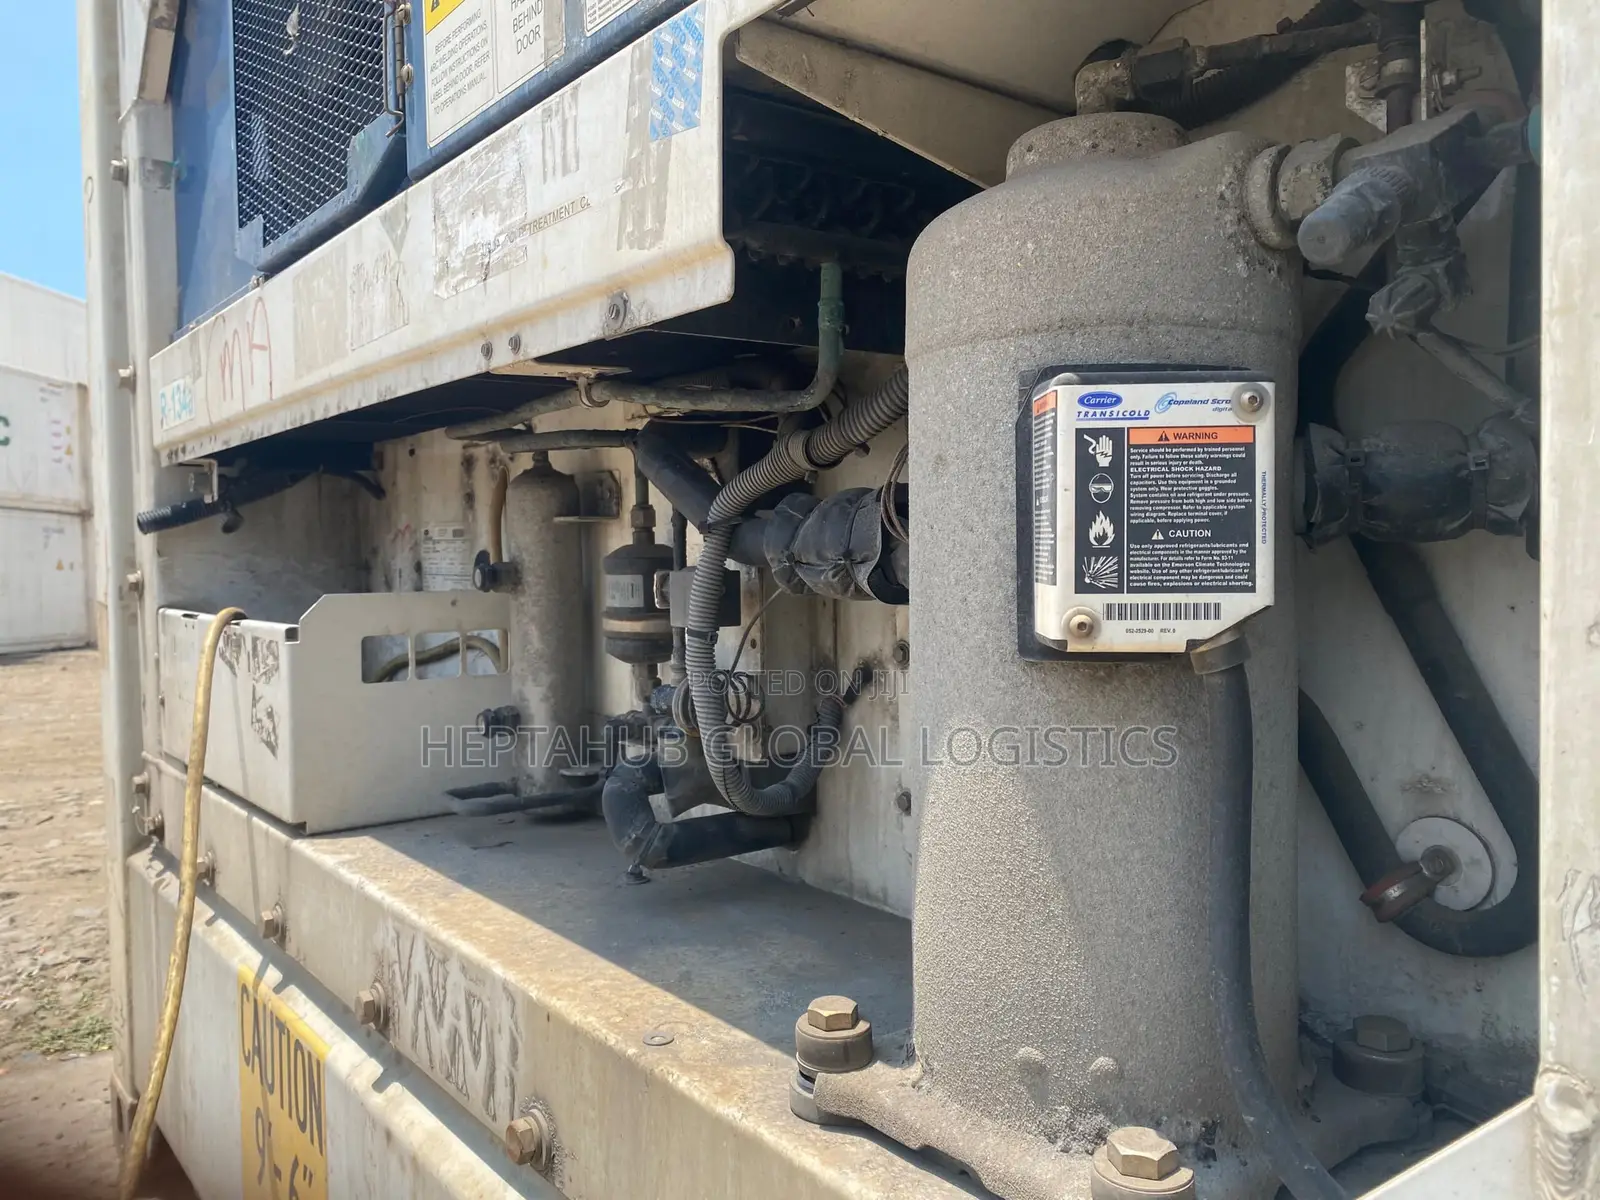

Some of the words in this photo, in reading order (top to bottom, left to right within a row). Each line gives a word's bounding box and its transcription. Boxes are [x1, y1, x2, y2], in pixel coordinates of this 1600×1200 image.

[512, 0, 545, 34] BEHIND
[435, 33, 451, 54] BEFORE
[452, 9, 481, 38] PERFORMING
[516, 25, 541, 55] DOOR
[528, 201, 576, 234] TREATMENT
[1084, 396, 1117, 405] Carrier
[1168, 399, 1209, 407] Copeland
[1077, 410, 1150, 418] TRANSICOLD
[1173, 432, 1218, 440] WARNING
[1168, 530, 1211, 538] CAUTION
[241, 983, 323, 1157] CAUTION
